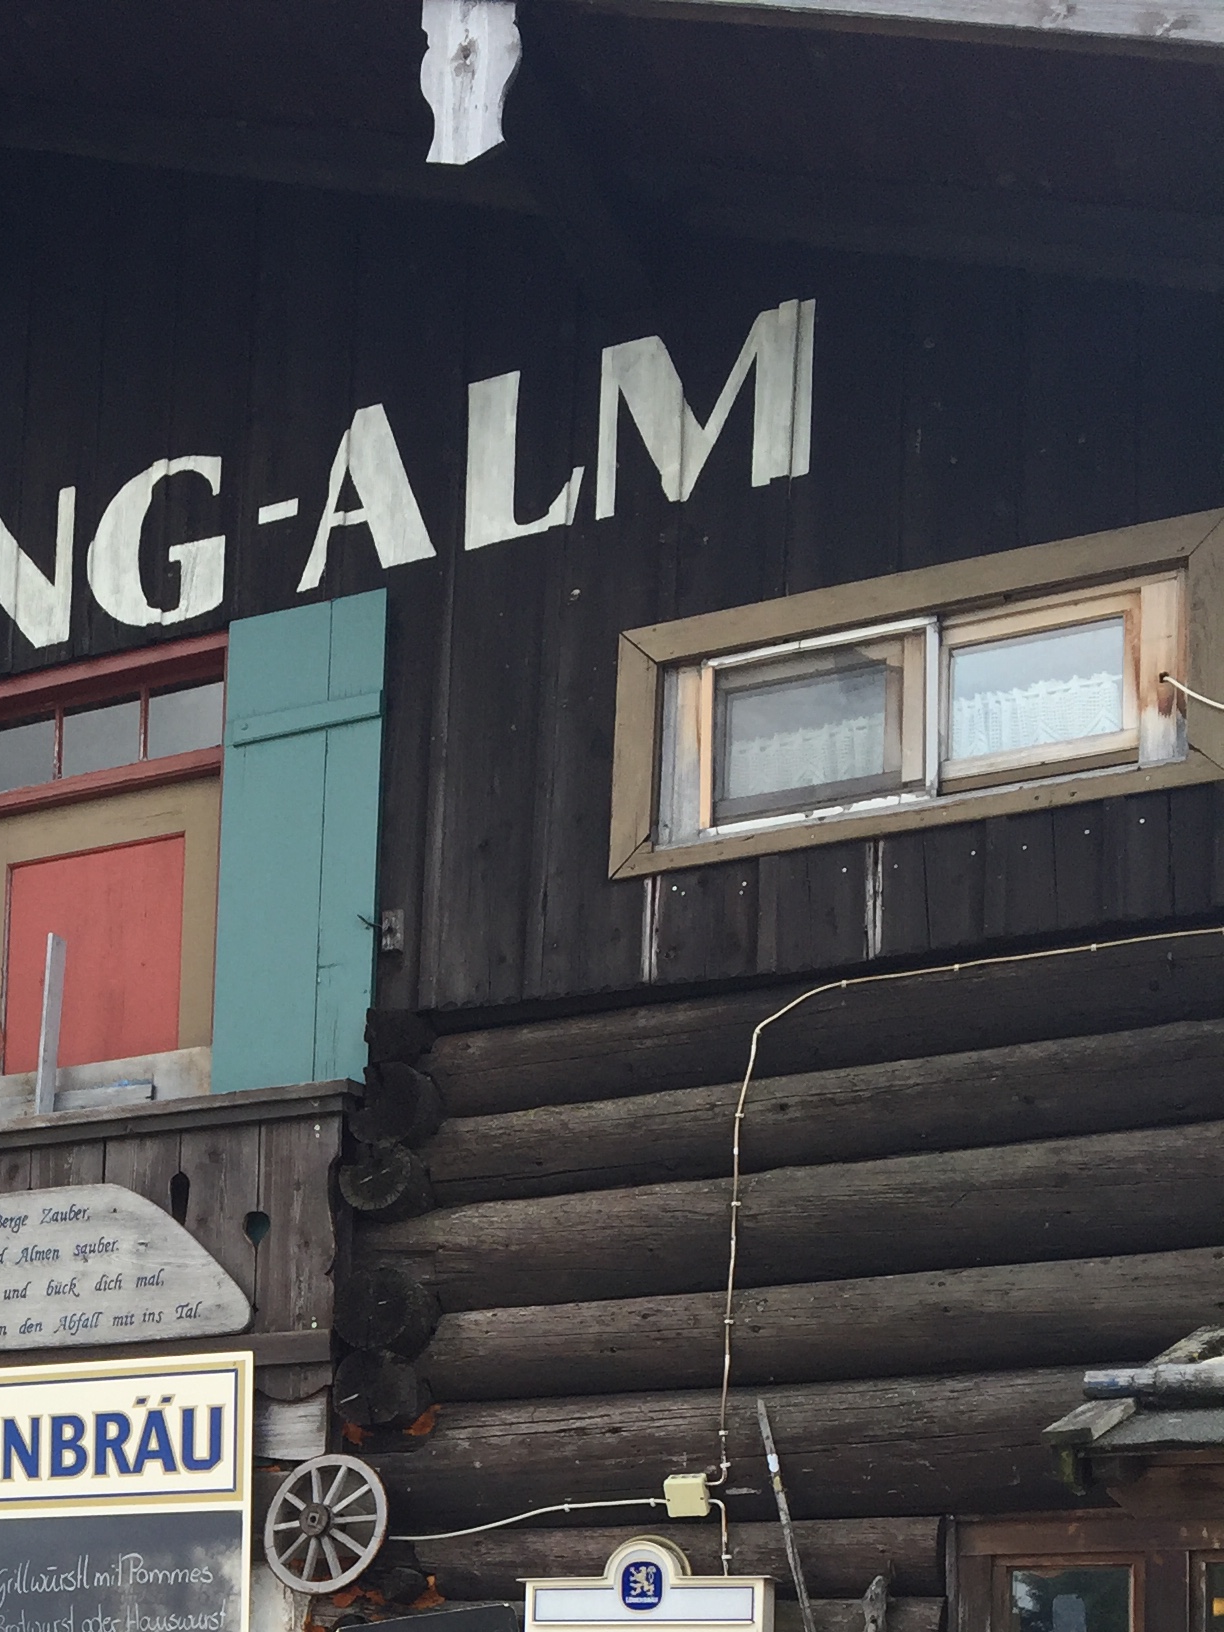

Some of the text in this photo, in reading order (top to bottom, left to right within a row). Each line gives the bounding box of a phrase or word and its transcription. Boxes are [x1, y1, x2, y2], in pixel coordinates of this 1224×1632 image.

[16, 1246, 60, 1265] Almen
[74, 1237, 120, 1257] sauber.
[4, 1282, 27, 1299] und
[95, 1274, 122, 1291] dich
[19, 1317, 43, 1335] den
[59, 1312, 102, 1336] Abfall
[112, 1308, 135, 1327] mit
[142, 1306, 162, 1324] ins
[175, 1301, 201, 1320] Tal.
[94, 1553, 122, 1586] mit
[121, 1552, 214, 1585] Pommes
[126, 1599, 226, 1632] Hauswurst
